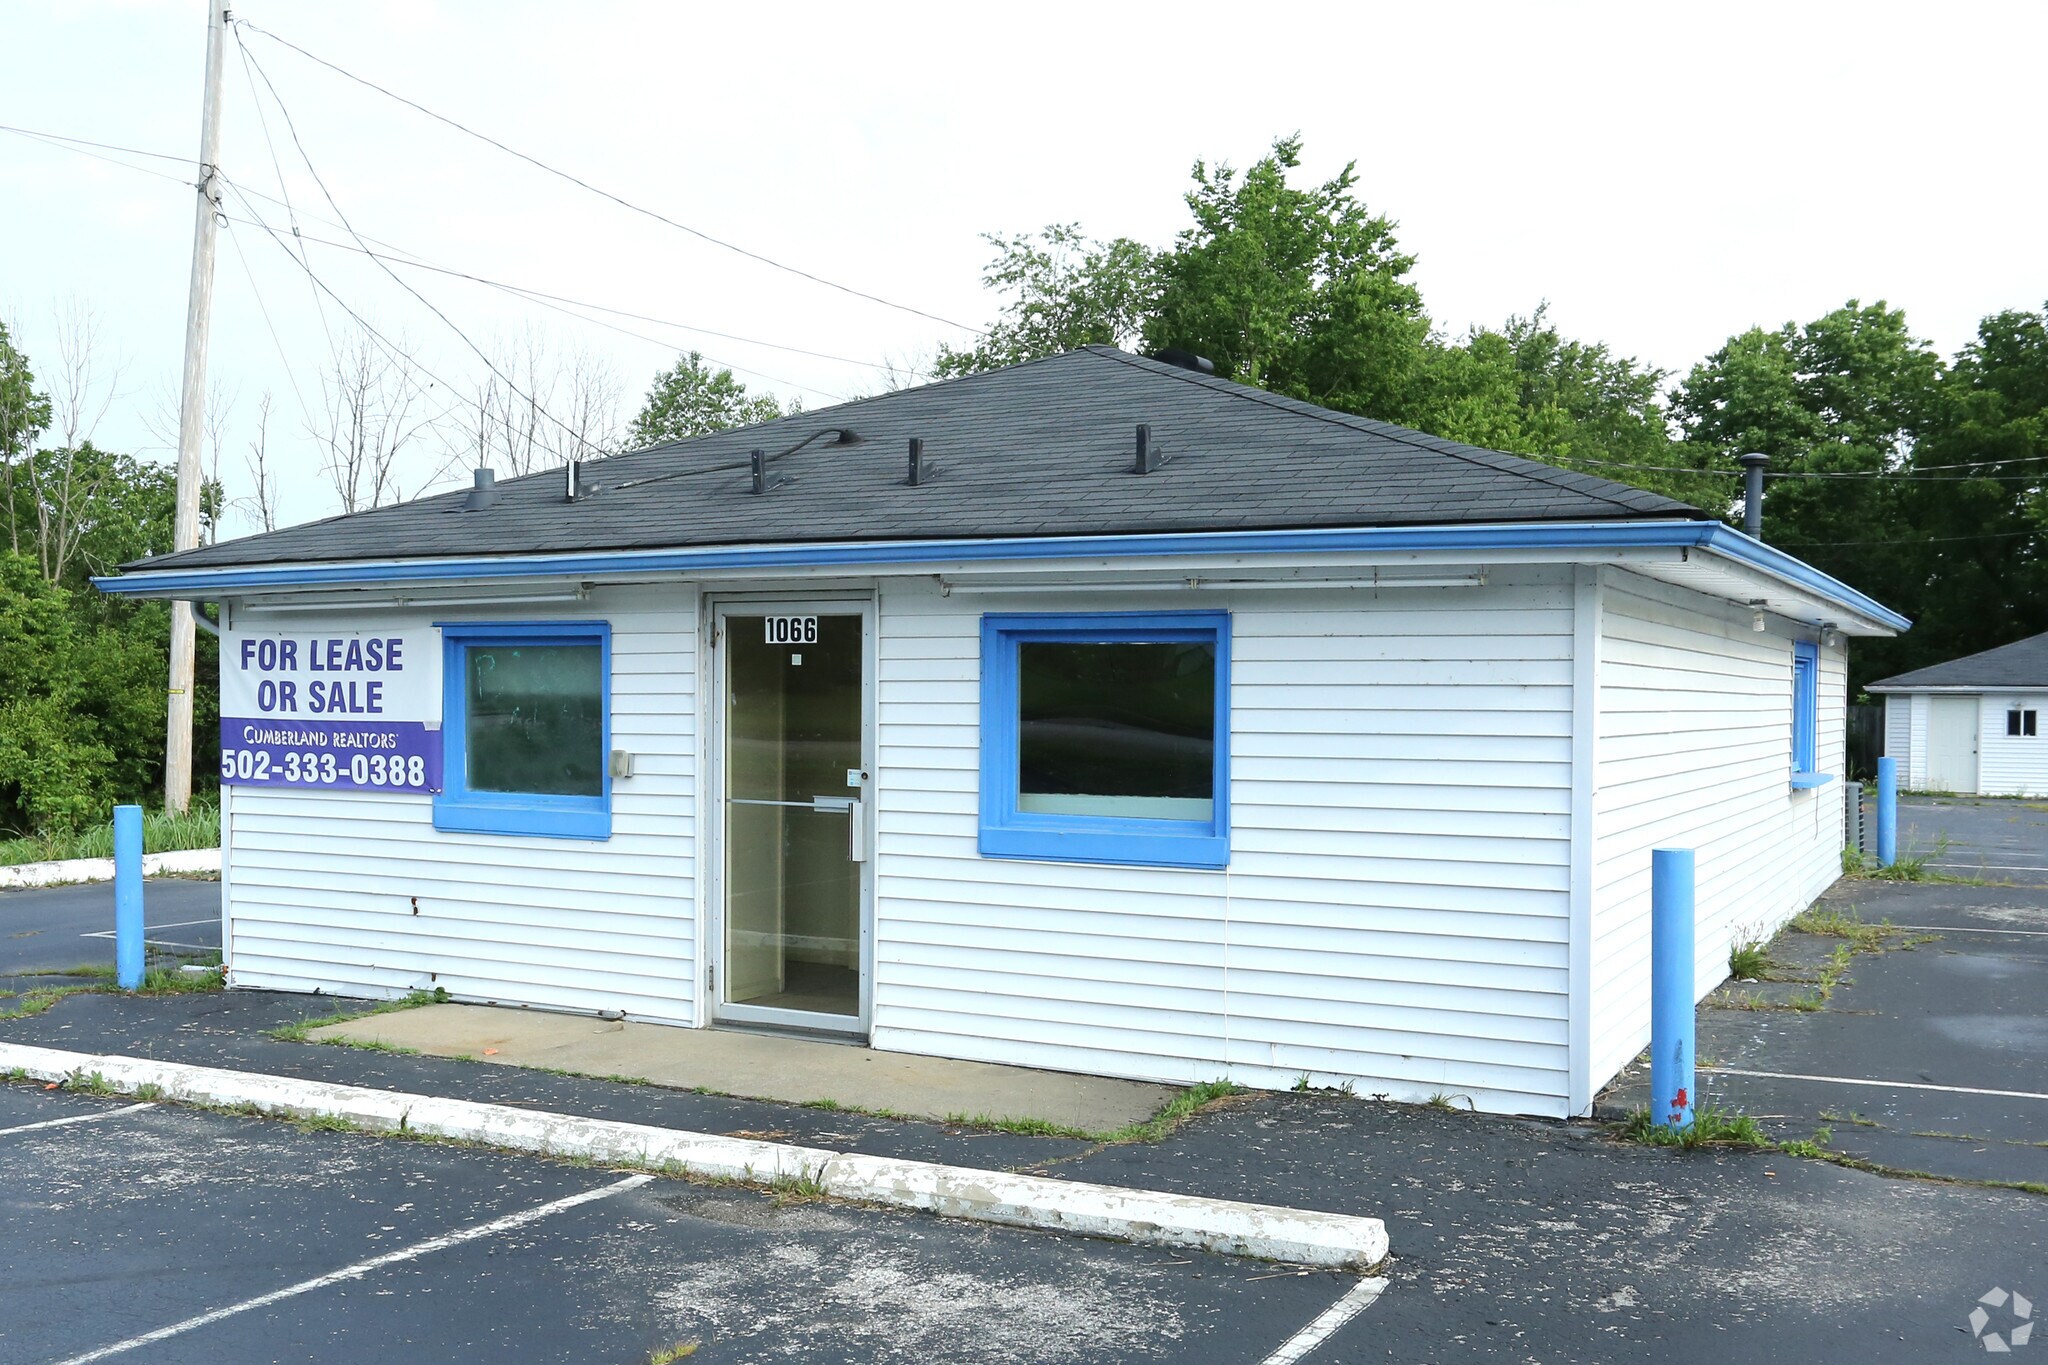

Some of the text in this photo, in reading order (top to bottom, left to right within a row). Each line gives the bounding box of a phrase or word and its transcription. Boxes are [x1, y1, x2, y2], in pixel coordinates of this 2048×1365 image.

[767, 617, 816, 642] 1066
[241, 638, 403, 671] FOR LEASE
[258, 680, 383, 713] OR SALE
[222, 749, 425, 786] 502-333-0388
